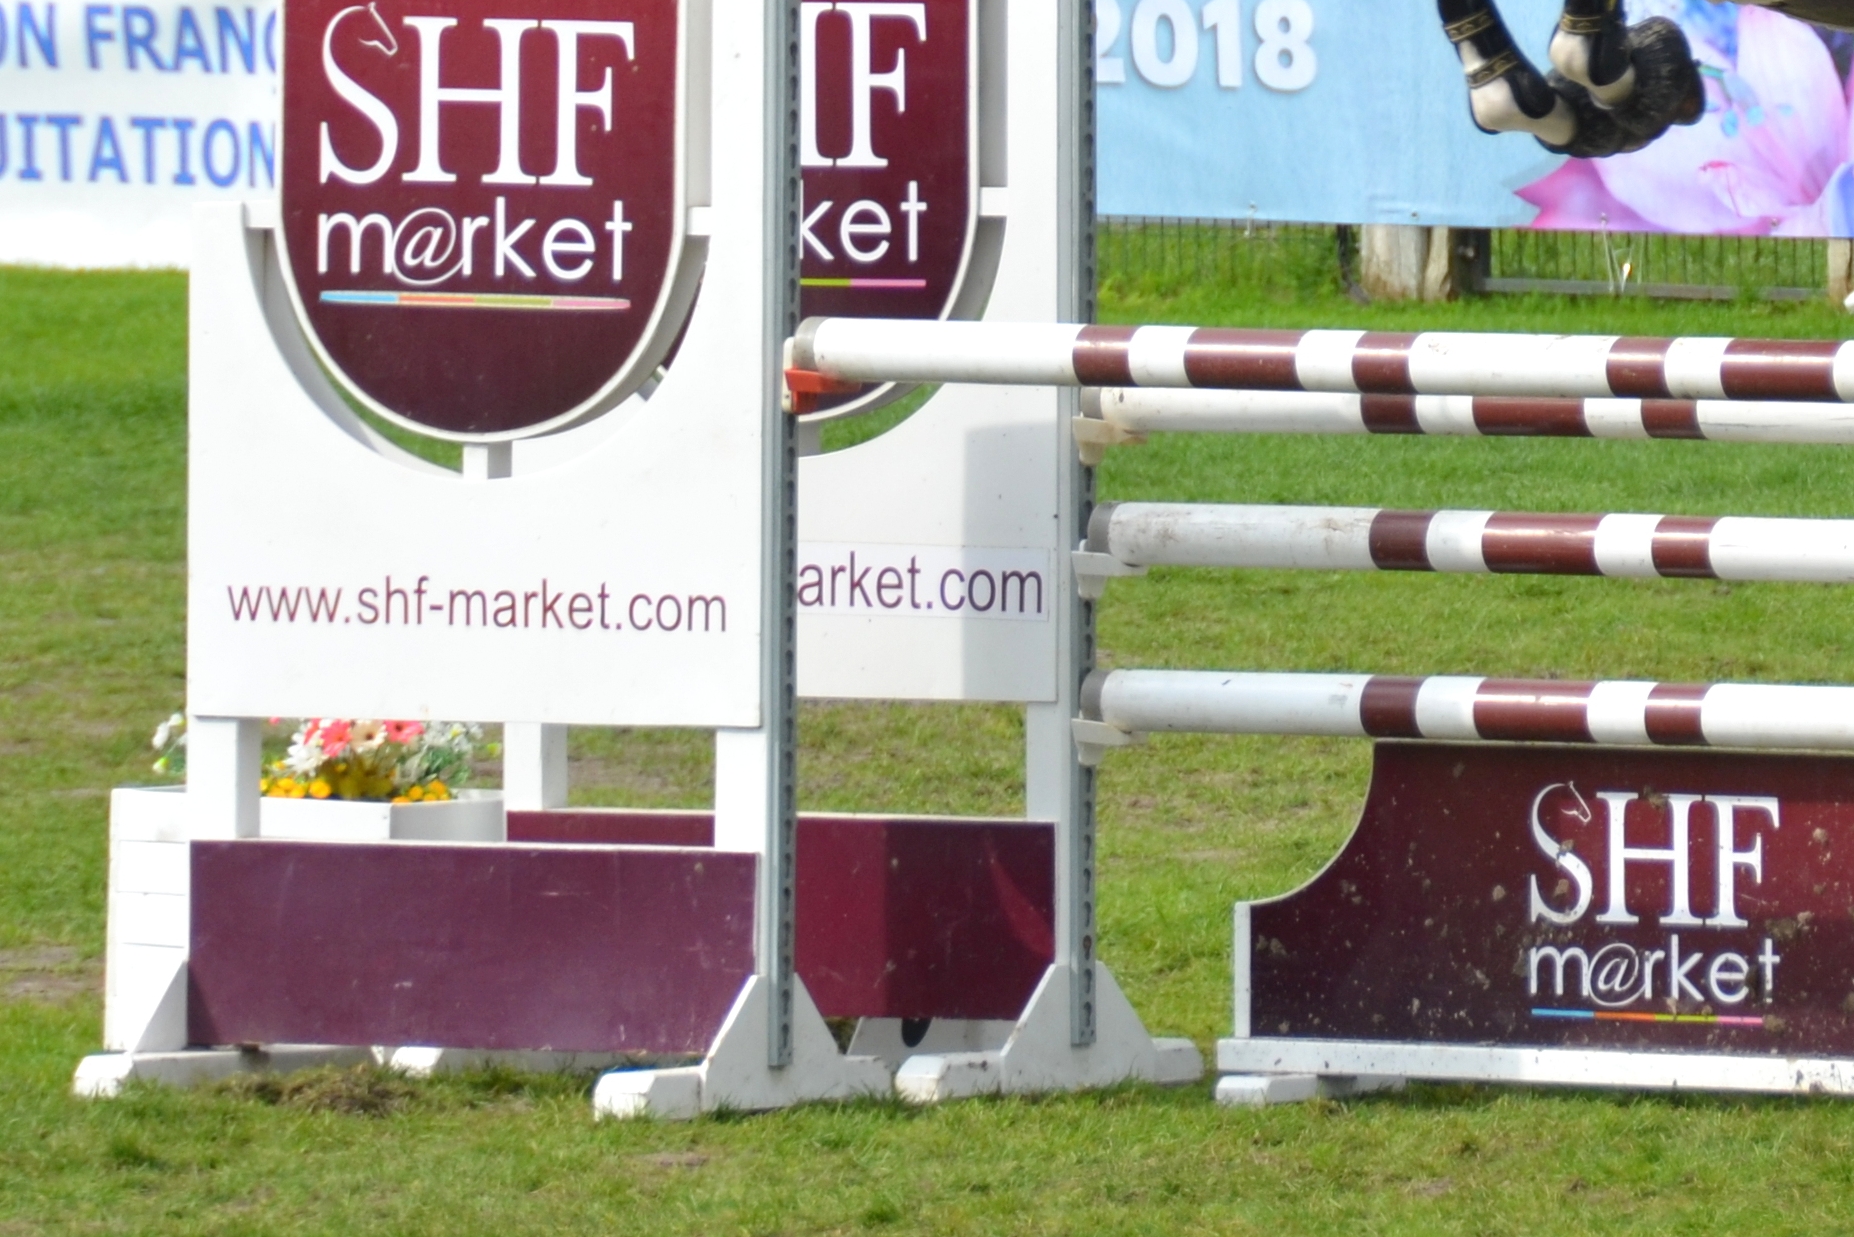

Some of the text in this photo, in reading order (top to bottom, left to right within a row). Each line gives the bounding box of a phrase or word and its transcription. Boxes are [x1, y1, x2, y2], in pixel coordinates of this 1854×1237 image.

[318, 1, 635, 186] SHF
[0, 111, 276, 189] ITATION
[317, 196, 633, 287] m@rket
[226, 574, 728, 633] www.shf-market.com
[797, 549, 1044, 615] arket.com
[1529, 780, 1781, 928] SHF
[1528, 933, 1781, 1008] m@rket
